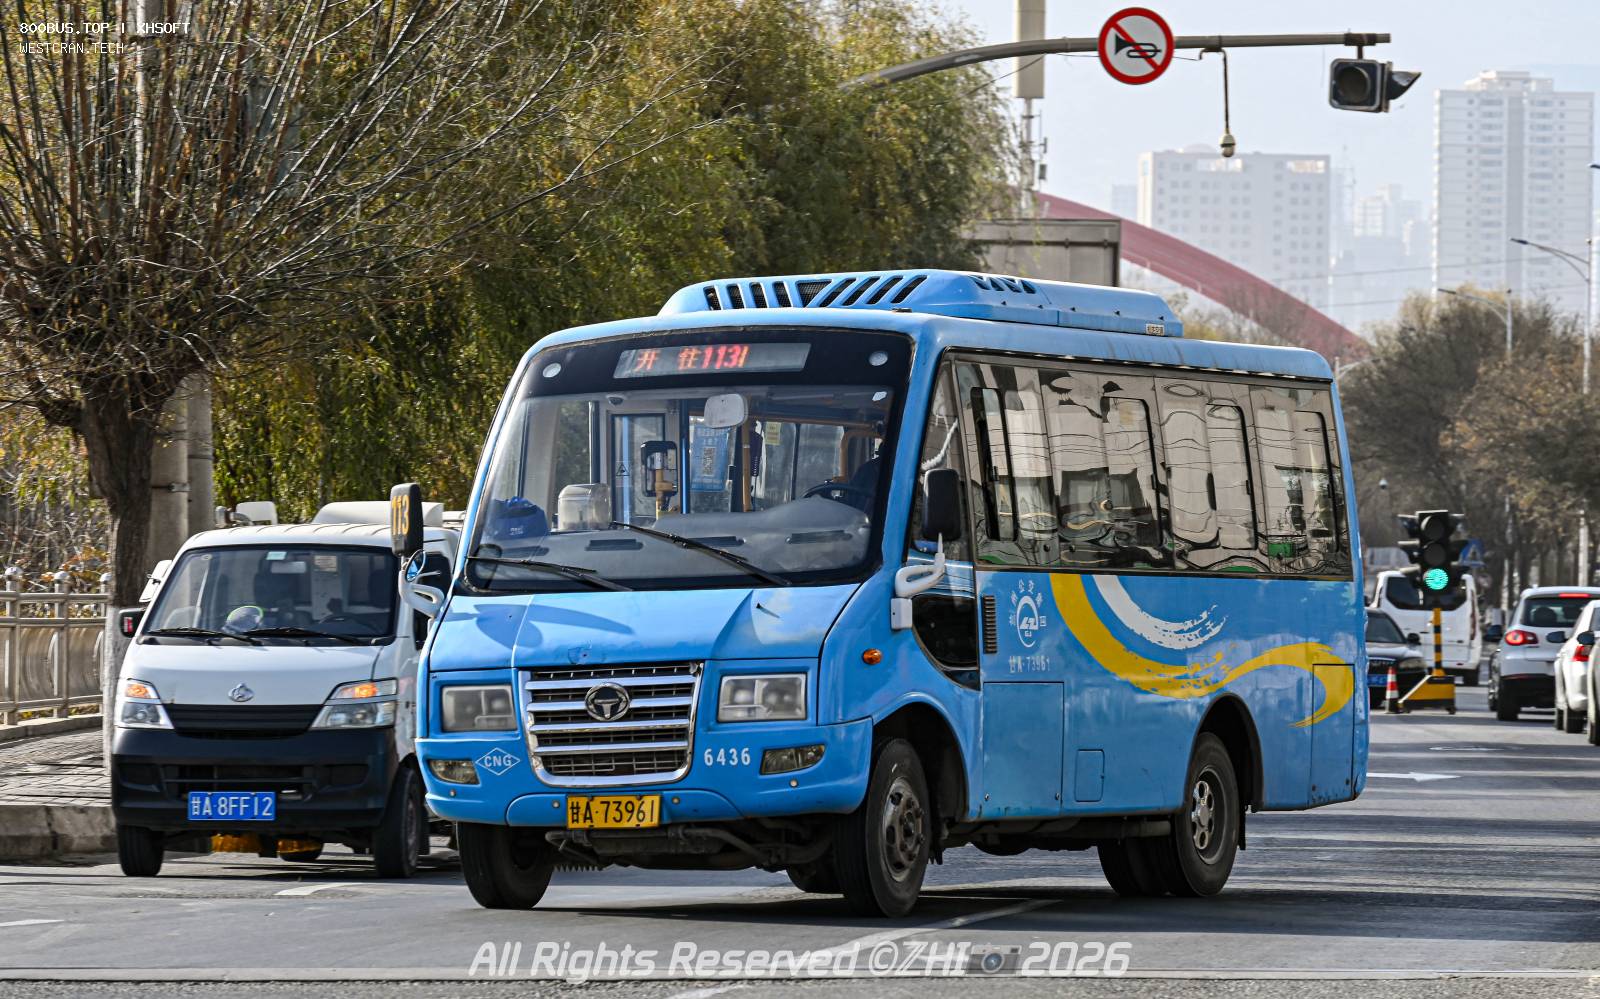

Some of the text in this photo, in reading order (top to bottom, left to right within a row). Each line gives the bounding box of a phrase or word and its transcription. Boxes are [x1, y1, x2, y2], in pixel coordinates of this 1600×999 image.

[391, 494, 410, 535] 113
[484, 754, 512, 767] CNG
[704, 747, 751, 766] 6436
